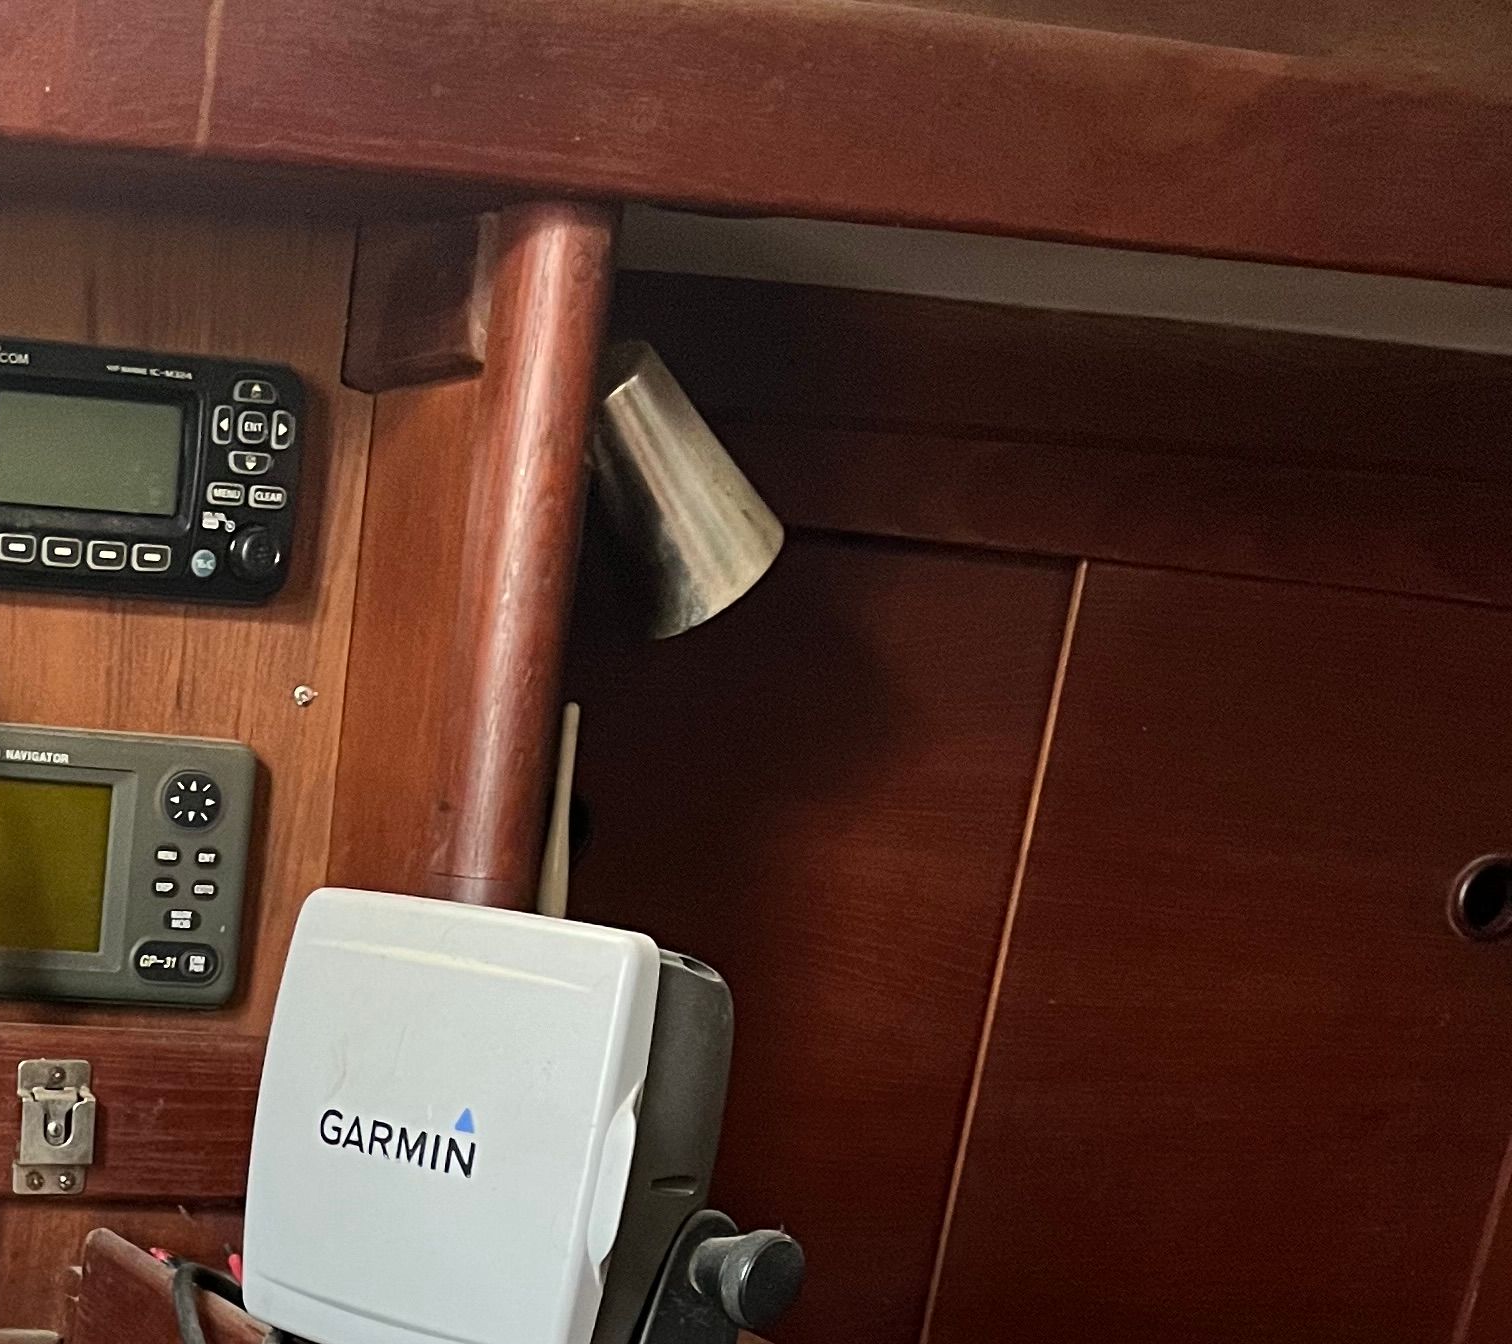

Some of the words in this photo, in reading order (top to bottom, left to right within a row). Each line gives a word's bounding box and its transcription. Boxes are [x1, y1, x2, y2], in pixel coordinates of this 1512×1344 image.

[254, 490, 283, 503] CLEAR
[5, 749, 70, 766] NAVIGATOR
[139, 954, 178, 971] GP-31
[320, 1109, 476, 1179] GARMIN
